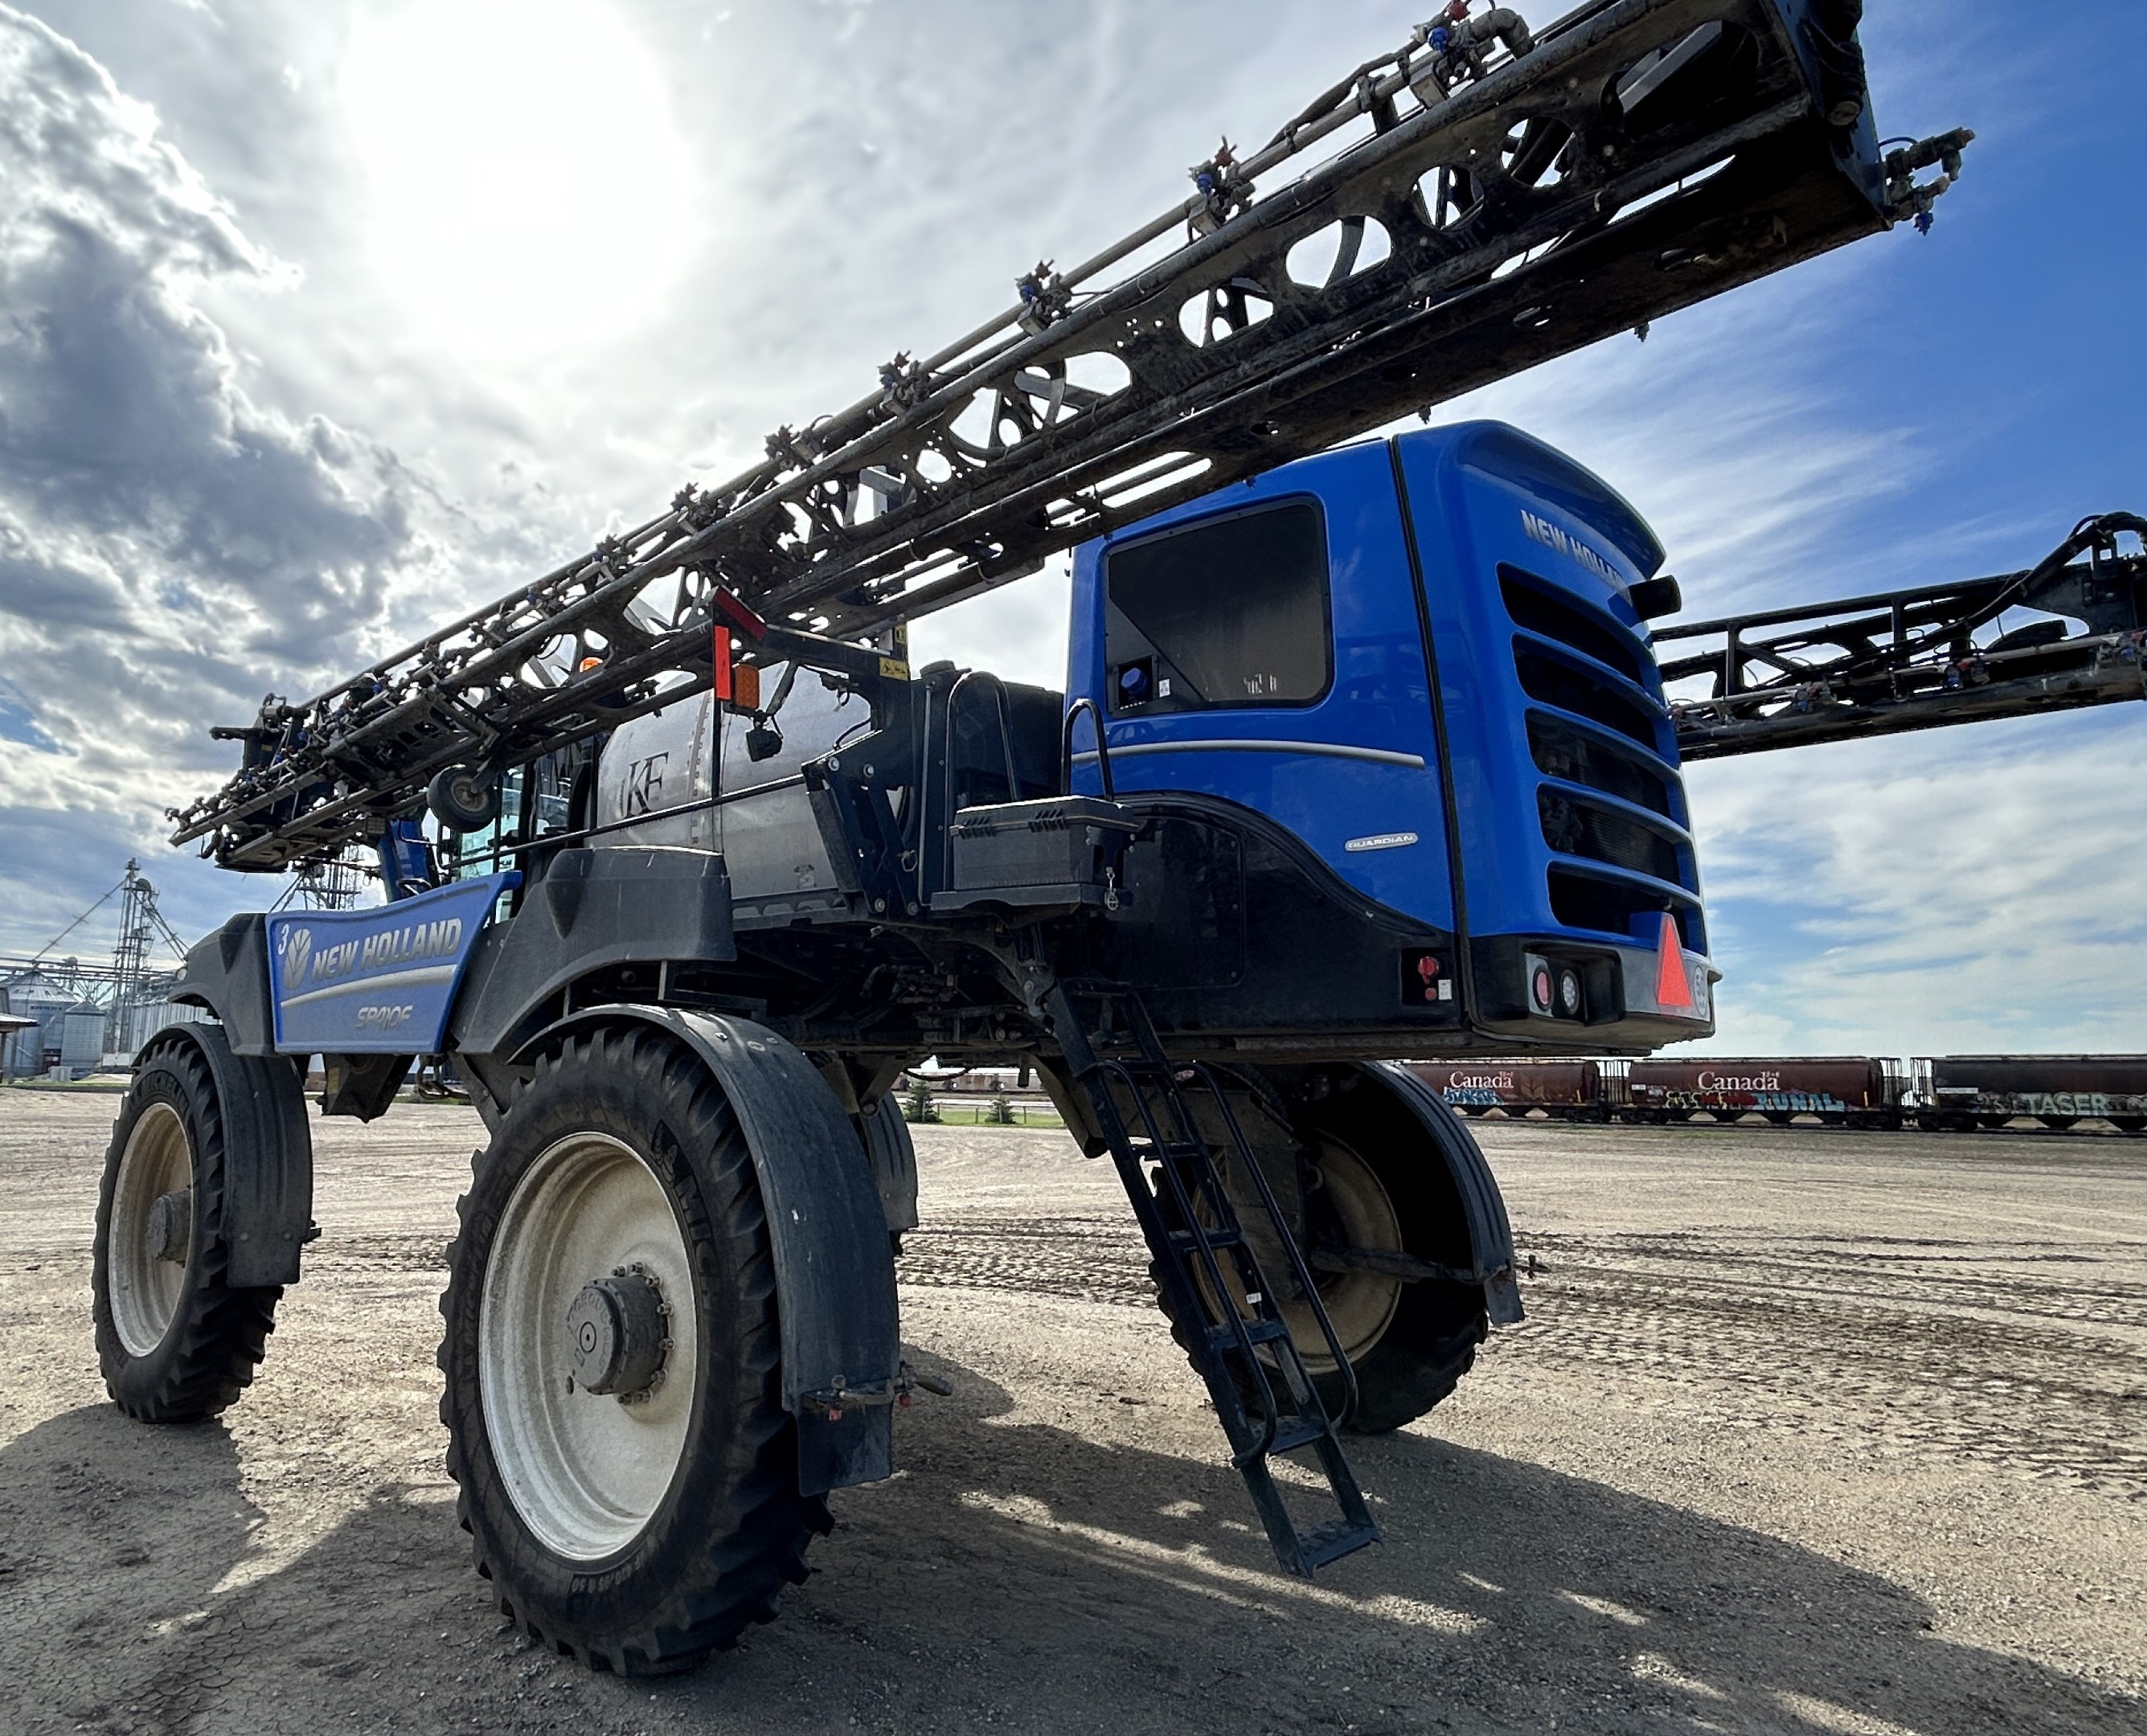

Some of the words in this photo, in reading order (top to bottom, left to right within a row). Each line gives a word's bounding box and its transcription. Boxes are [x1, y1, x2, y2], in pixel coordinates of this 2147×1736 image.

[1521, 509, 1569, 555] NEW
[1349, 836, 1413, 849] GUARDIAN
[277, 923, 289, 956] 3
[312, 940, 359, 982] NEW
[361, 917, 463, 970] HOLLAND
[1449, 1071, 1514, 1089] Canada
[1698, 1070, 1780, 1091] Canada
